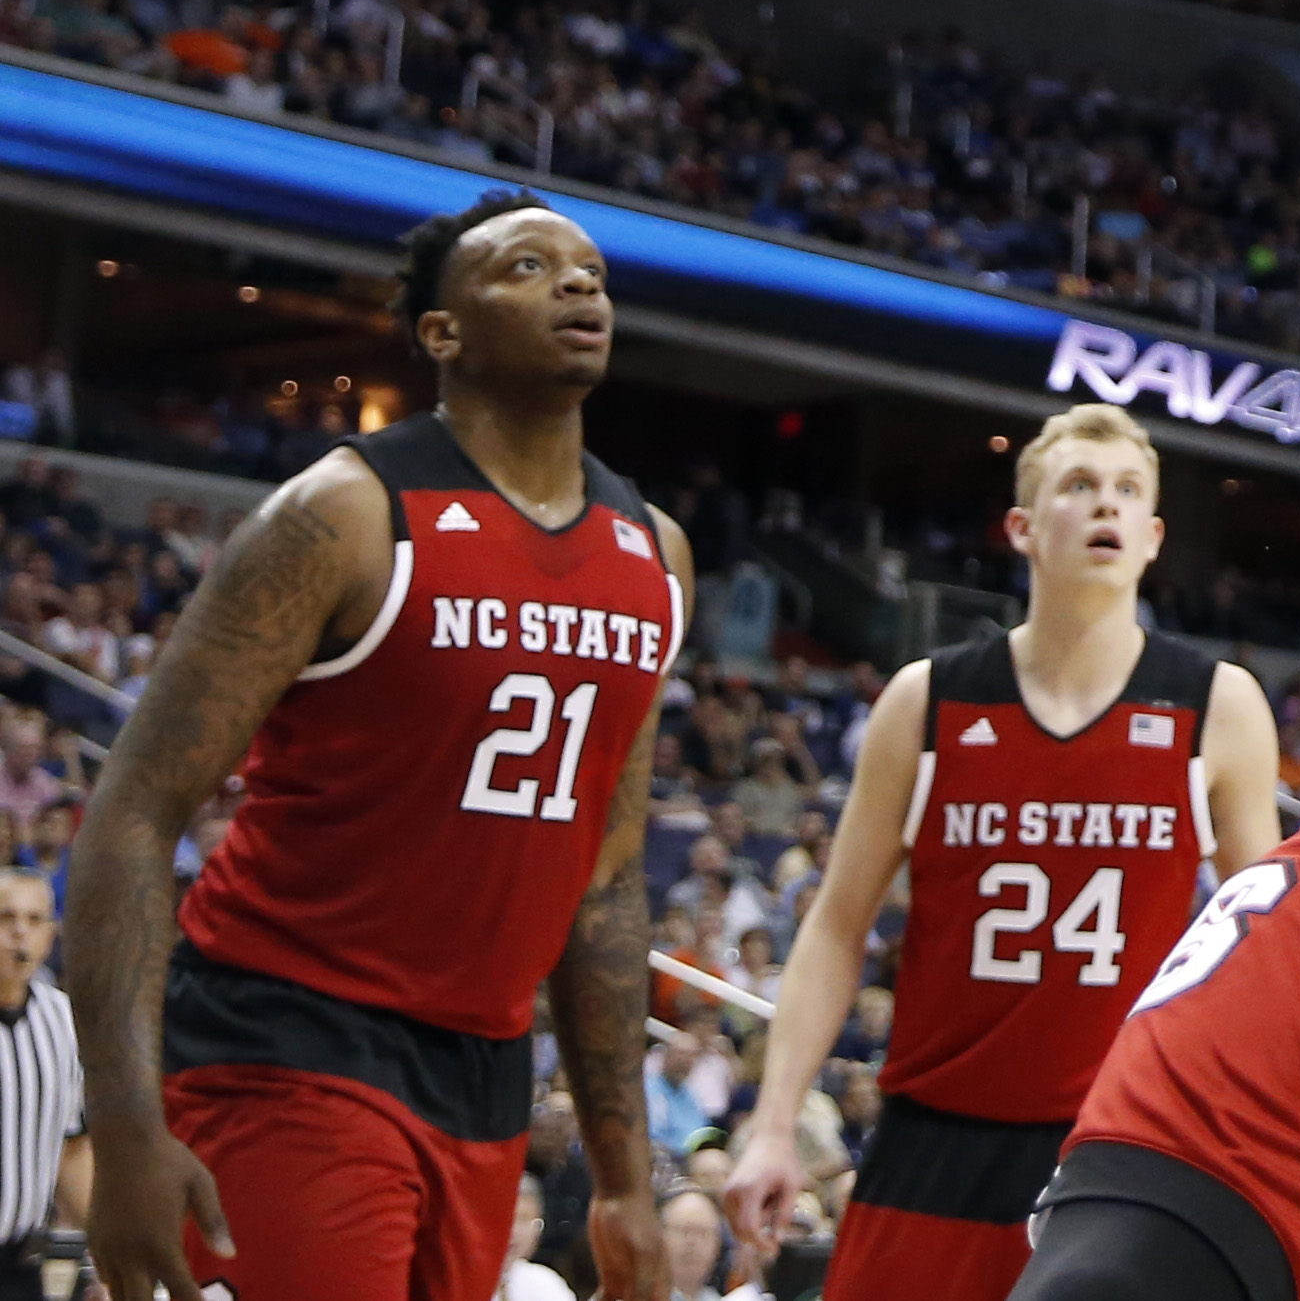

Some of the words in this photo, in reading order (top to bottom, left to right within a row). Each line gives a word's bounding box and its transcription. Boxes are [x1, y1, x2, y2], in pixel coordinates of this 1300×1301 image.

[430, 597, 508, 649] NC
[518, 601, 663, 674] STATE
[460, 672, 599, 823] 21
[942, 802, 1009, 848] NC
[1016, 801, 1178, 850] STATE
[969, 861, 1127, 987] 24
